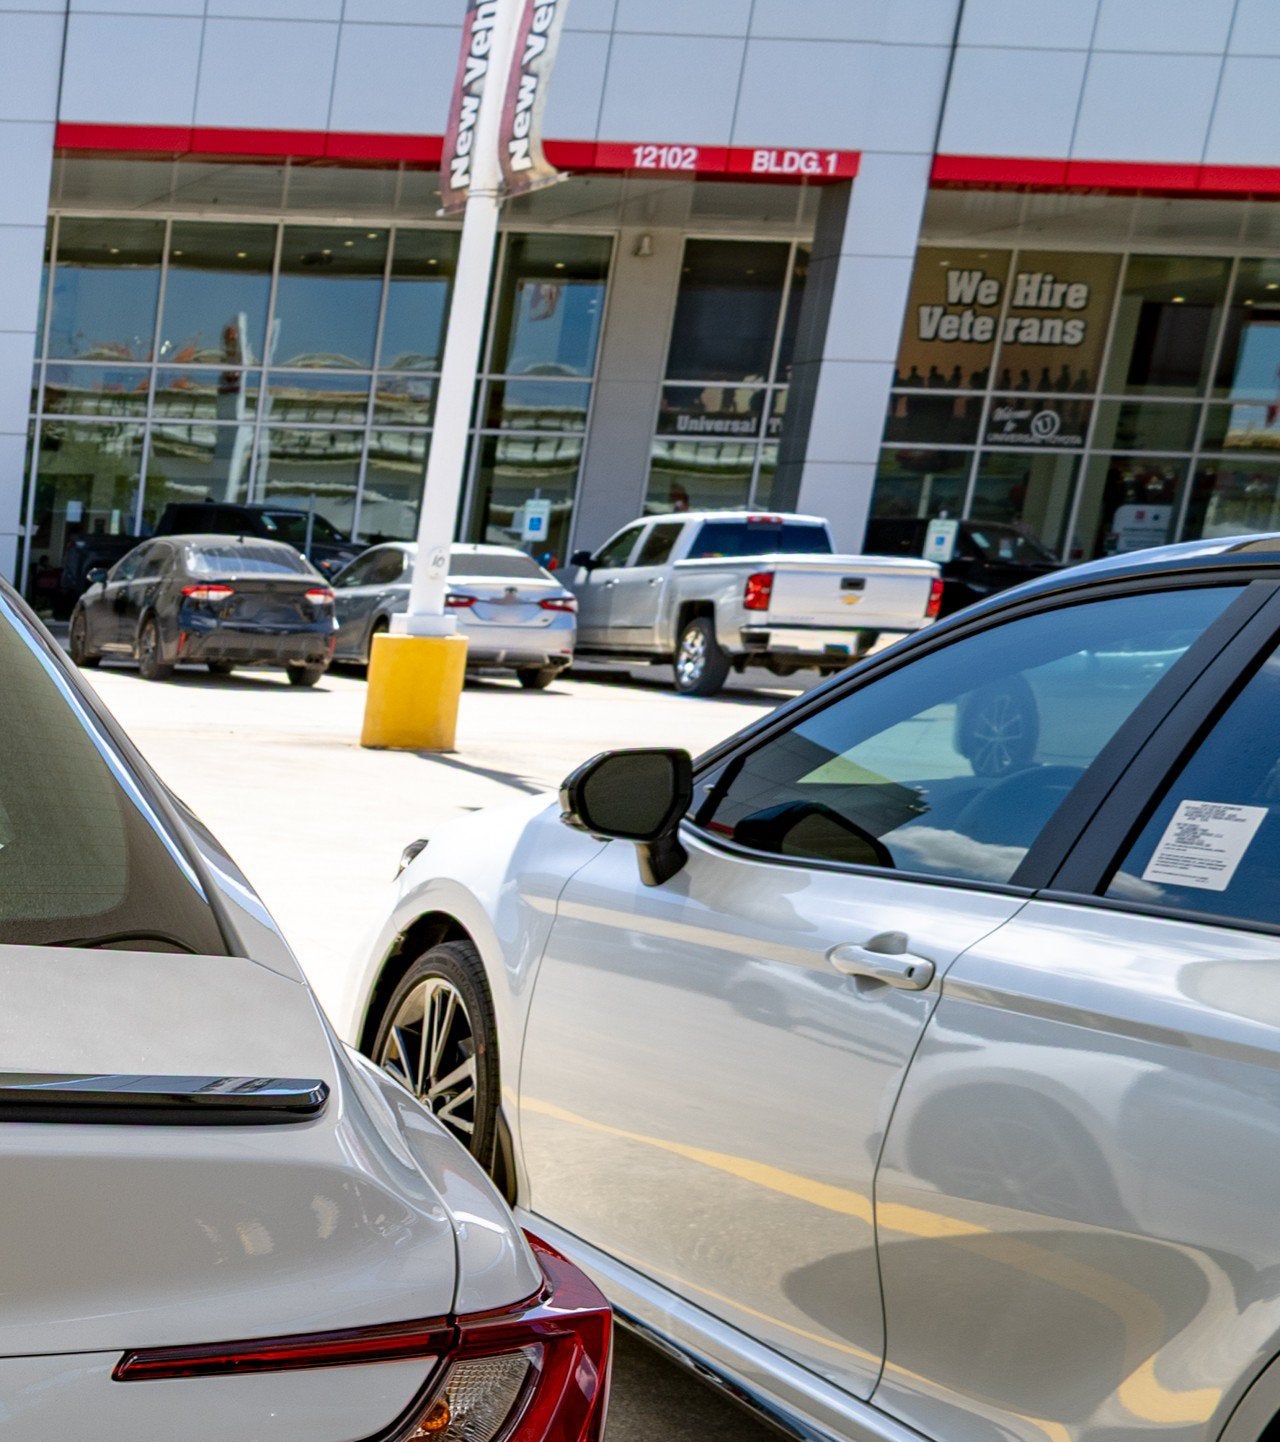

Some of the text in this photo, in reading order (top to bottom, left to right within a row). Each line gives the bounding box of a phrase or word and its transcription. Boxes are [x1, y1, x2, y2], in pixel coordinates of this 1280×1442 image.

[450, 0, 498, 190] New Veh
[508, 0, 557, 173] New Ve
[633, 146, 698, 169] 12102
[947, 270, 1088, 309] We Hire
[919, 305, 1085, 345] Veterans
[676, 415, 758, 433] Universal
